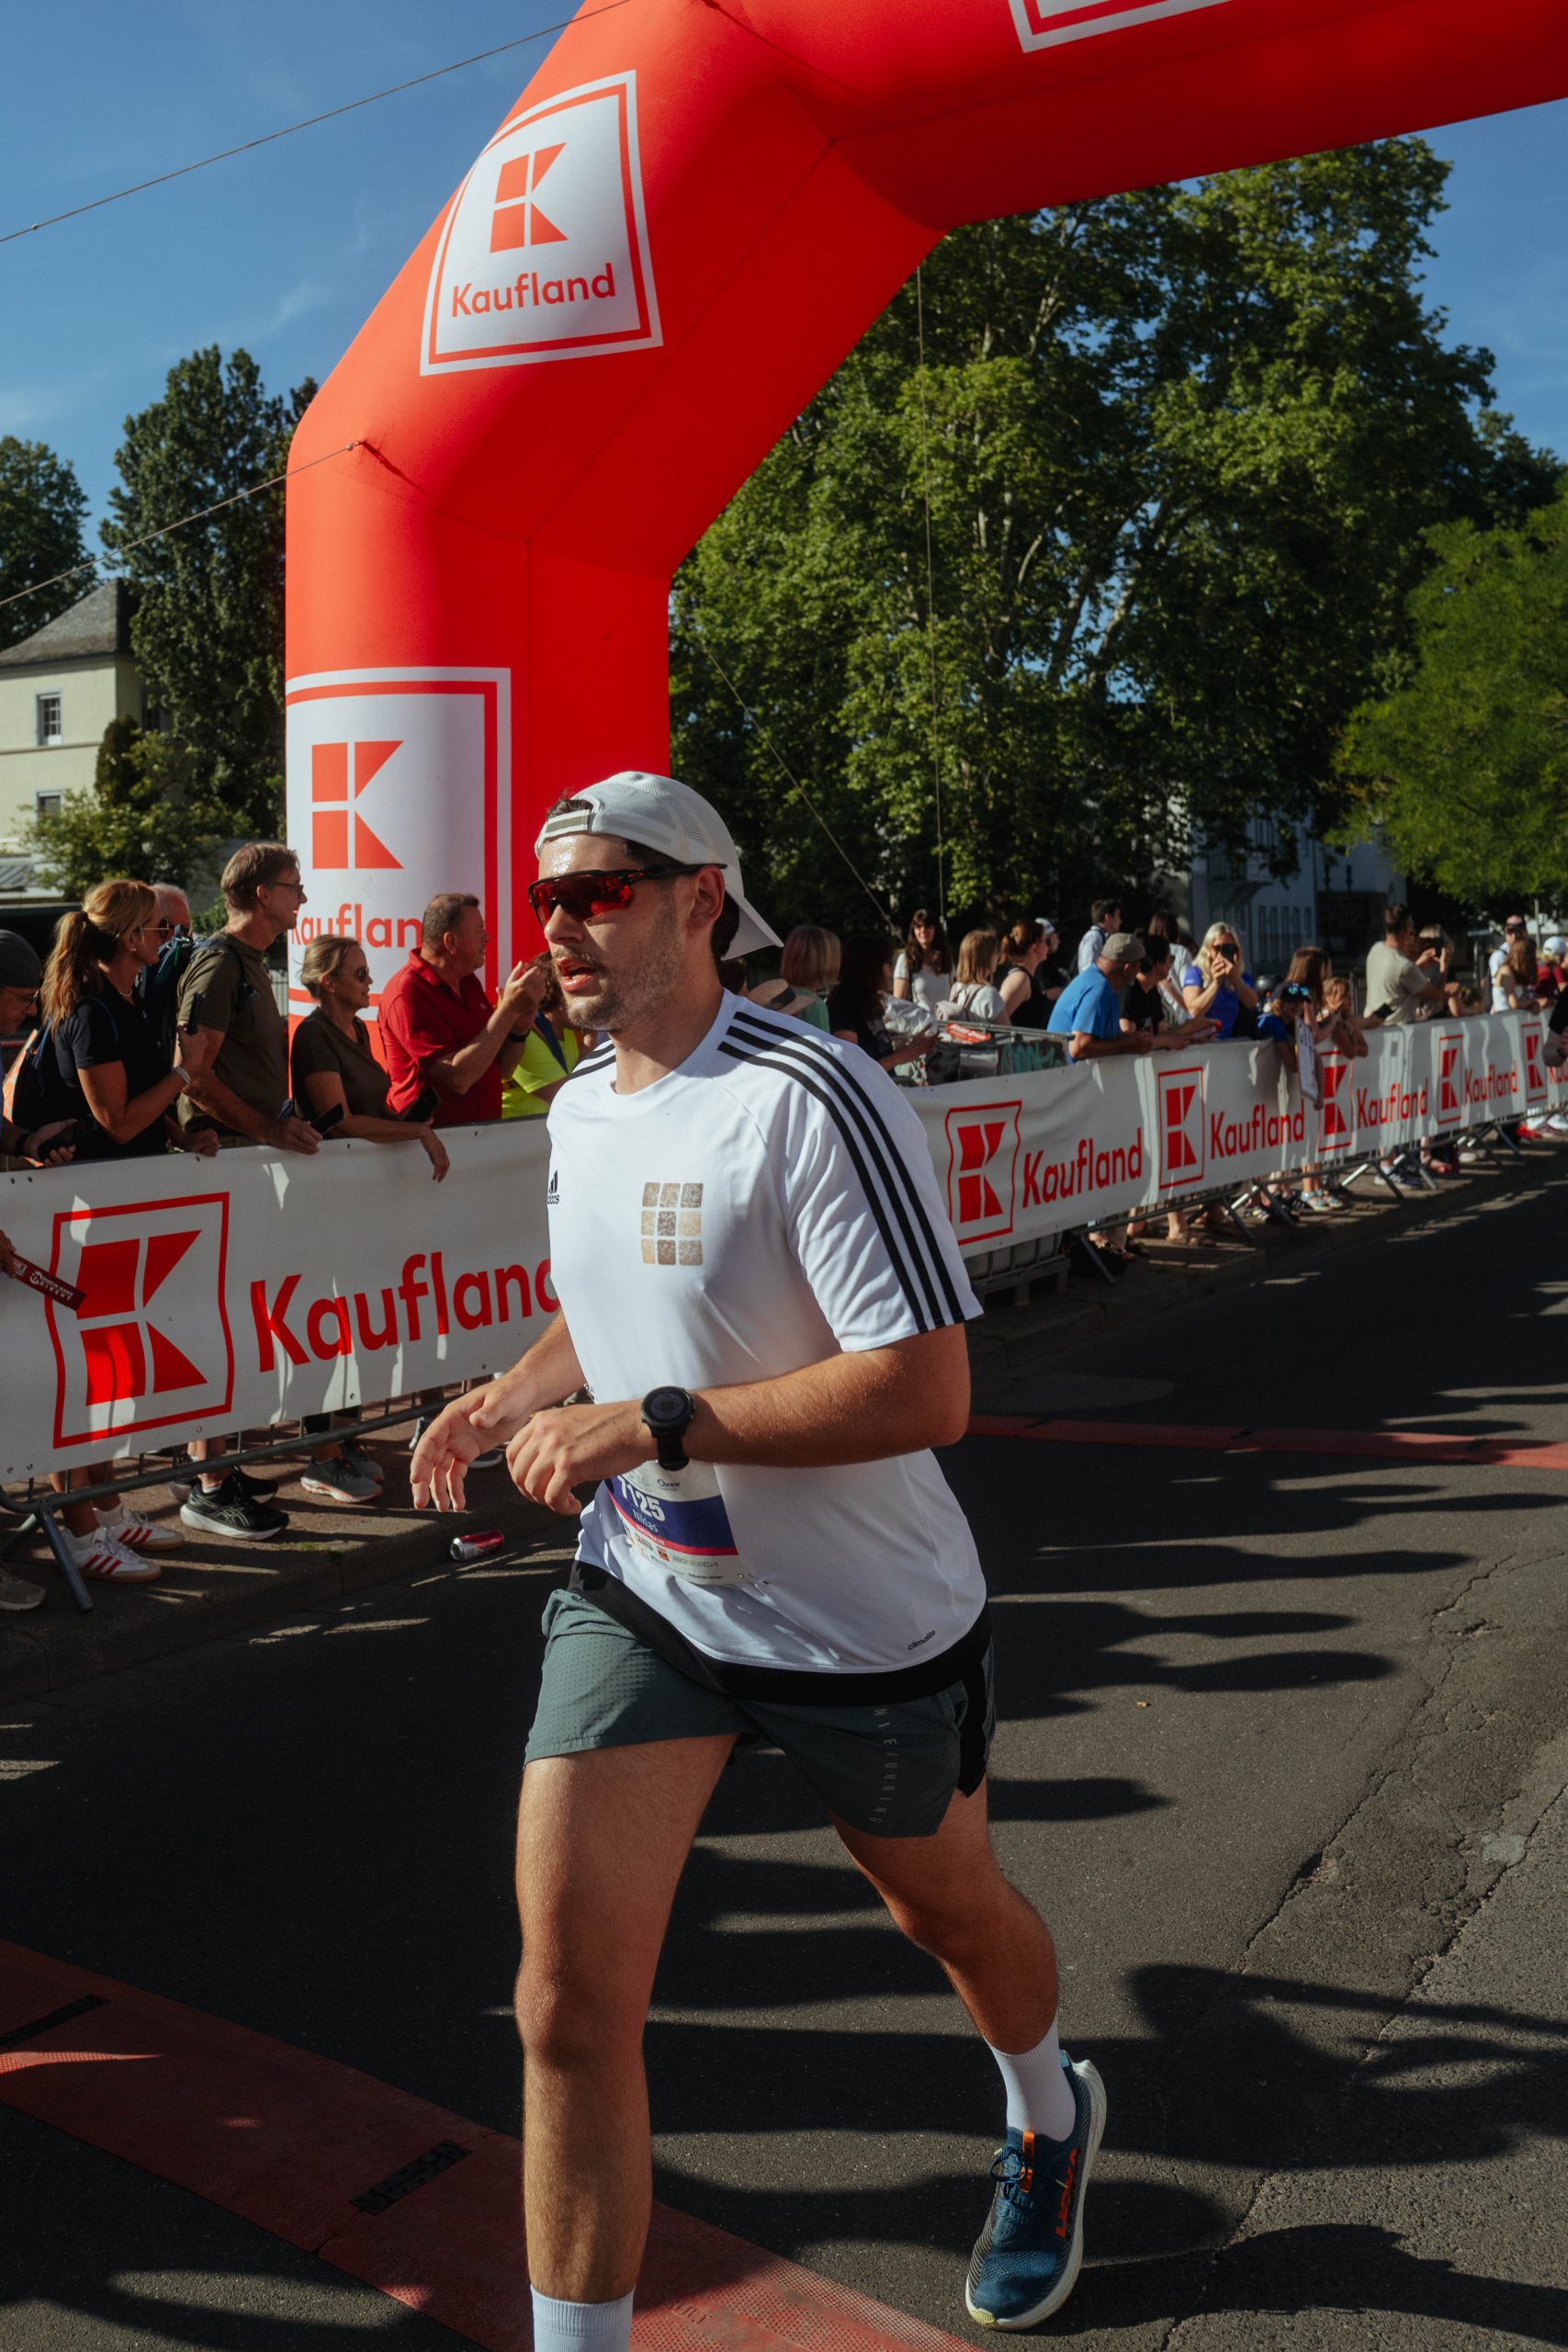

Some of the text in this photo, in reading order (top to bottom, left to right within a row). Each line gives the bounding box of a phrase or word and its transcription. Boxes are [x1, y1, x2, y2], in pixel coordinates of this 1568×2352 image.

[451, 263, 616, 318] Kaufland
[291, 902, 423, 948] auflan
[1357, 1078, 1429, 1129] Kaufland
[1463, 1060, 1518, 1105] Kaufland
[1210, 1098, 1304, 1160] Kaufland
[1021, 1127, 1143, 1209] Kaufland
[616, 1475, 666, 1522] 7125
